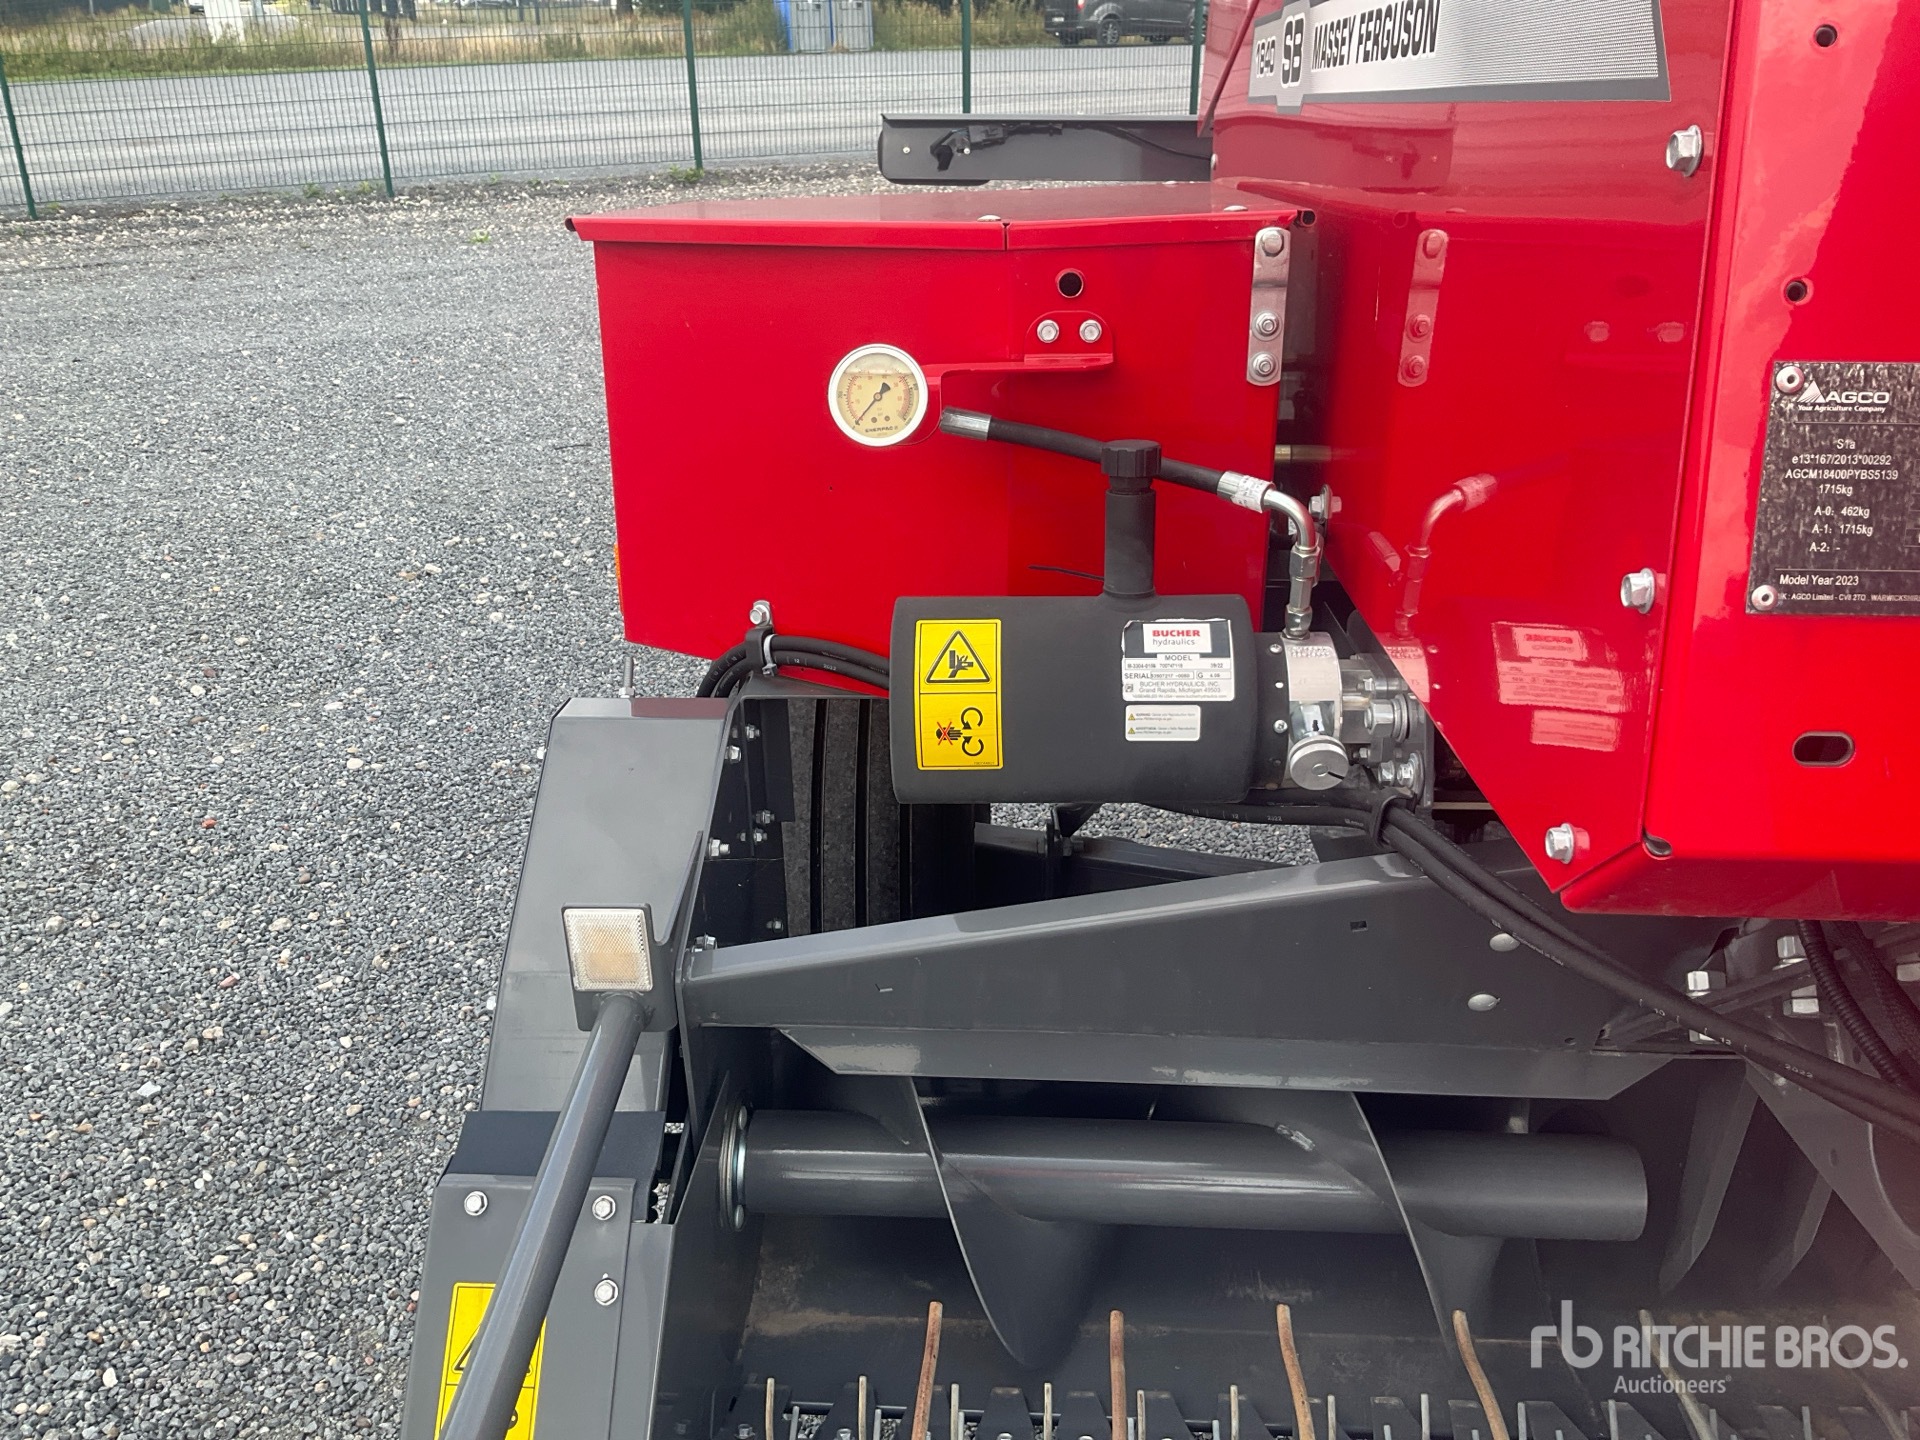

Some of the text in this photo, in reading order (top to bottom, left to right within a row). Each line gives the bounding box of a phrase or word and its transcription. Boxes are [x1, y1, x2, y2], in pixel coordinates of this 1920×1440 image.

[1312, 0, 1440, 70] MASSEY FERGUSON
[1256, 13, 1305, 88] 1840 SB
[1826, 390, 1890, 404] AGCO
[1798, 404, 1887, 414] Your Agriculture Company
[1836, 438, 1856, 450] S1a
[1785, 468, 1899, 480] AGCM18400PYBS5139
[1818, 484, 1853, 497] 1715kg
[1813, 505, 1870, 518] A-0: 462kg
[1811, 524, 1873, 537] A-1: 1715kg
[1809, 542, 1831, 553] A-2:
[1779, 574, 1860, 587] Model Year 2023
[1151, 629, 1201, 637] BUCHER
[1152, 638, 1196, 647] hydraulics
[1124, 672, 1150, 680] SERIAL
